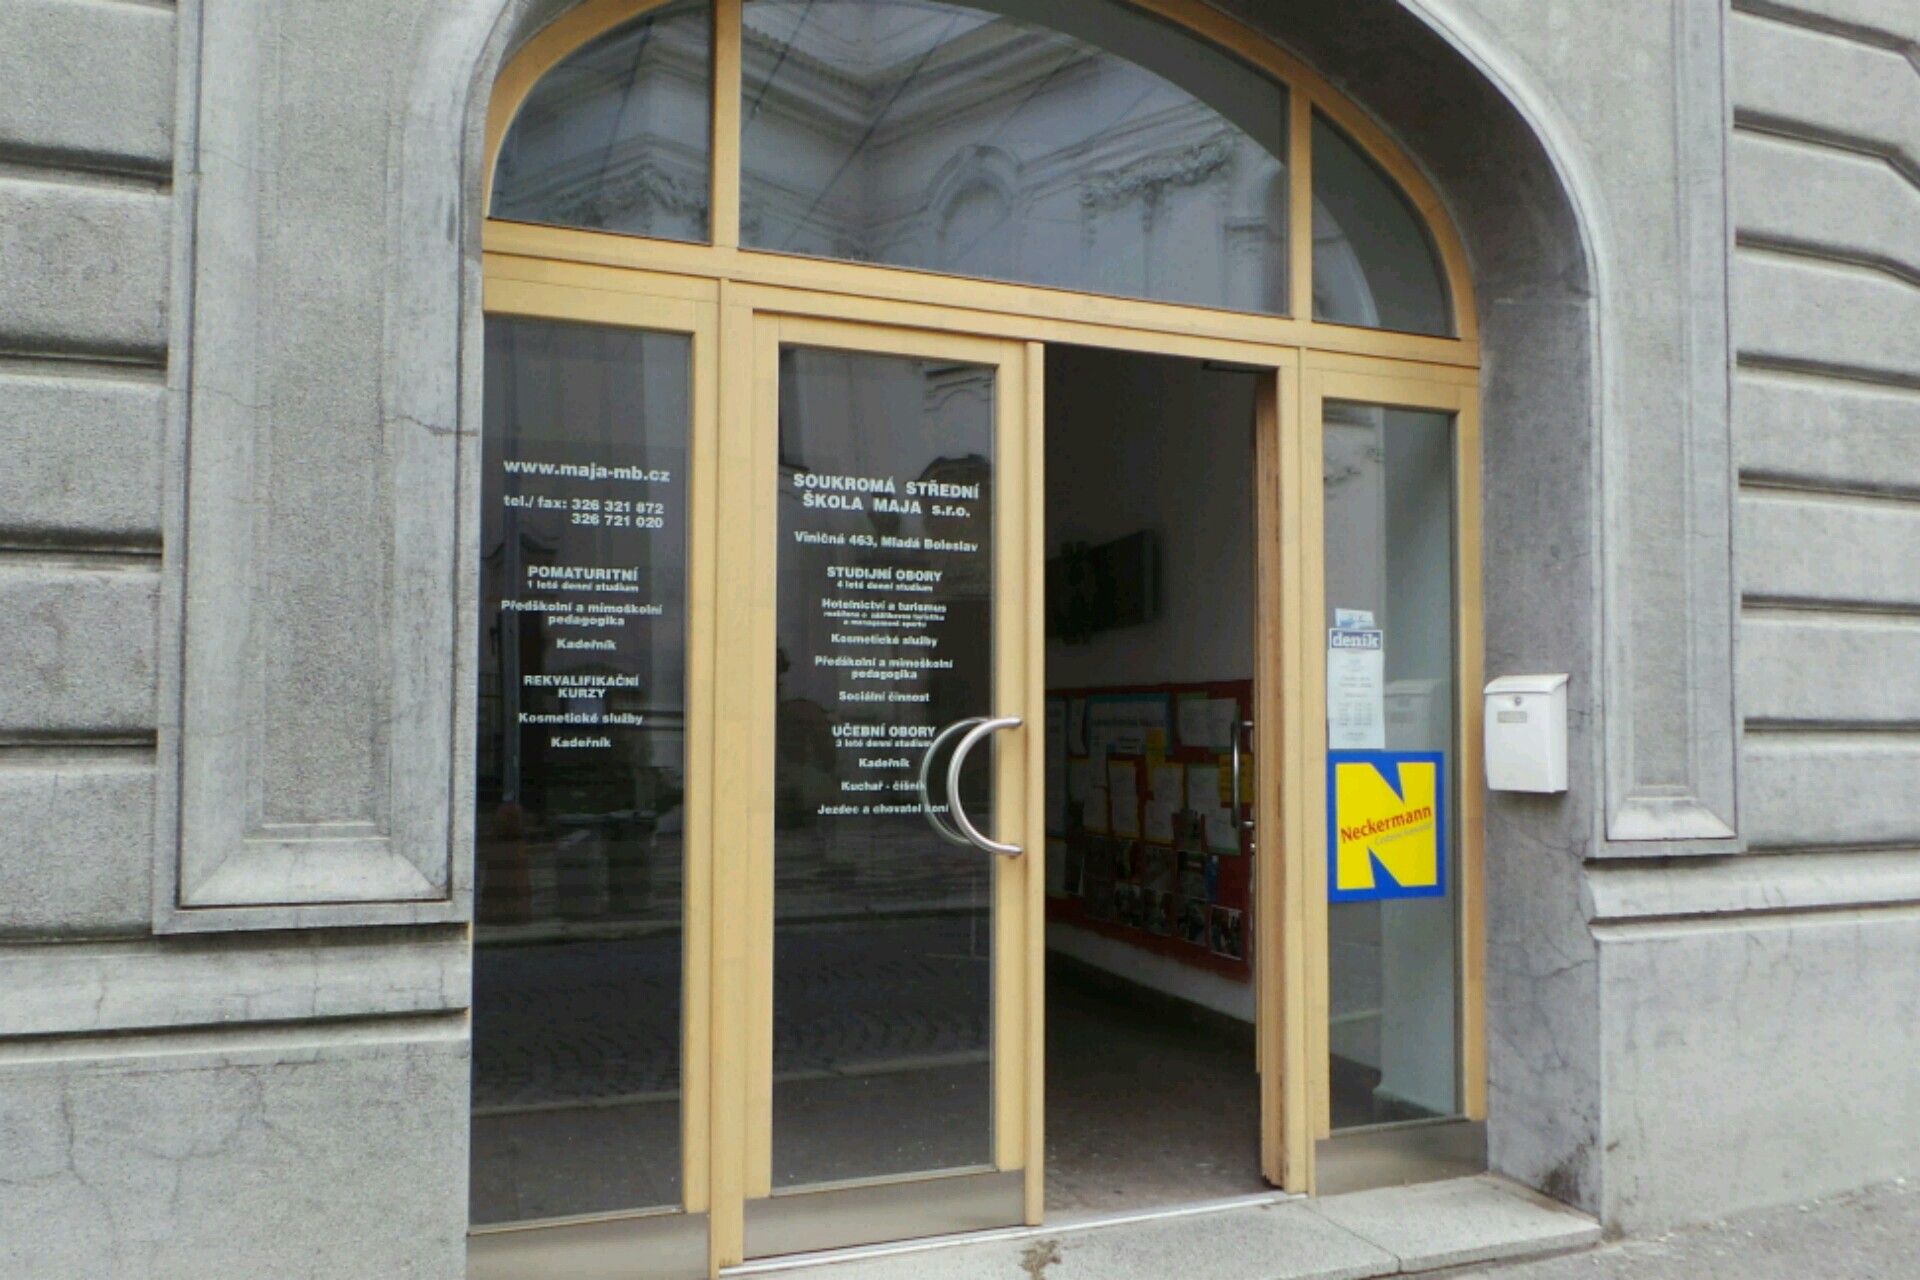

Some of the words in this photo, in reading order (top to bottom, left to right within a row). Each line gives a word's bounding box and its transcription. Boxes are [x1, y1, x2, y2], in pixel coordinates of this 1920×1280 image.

[503, 460, 671, 482] www.maja-mb.cz
[793, 473, 896, 494] SOUKROMÁ
[906, 480, 980, 499] STŘEDNÍ
[537, 496, 567, 509] fax:
[571, 498, 600, 511] 326
[604, 500, 631, 513] 321
[635, 502, 664, 515] 872
[803, 489, 864, 511] ŠKOLA
[873, 498, 922, 515] MAJA
[932, 504, 971, 518] s.r.o.
[571, 513, 600, 526] 326
[604, 514, 631, 527] 721
[635, 516, 664, 528] 020
[794, 530, 845, 545] Viničná
[880, 535, 920, 549] Mladá
[924, 538, 979, 552] Boleslav
[527, 564, 639, 582] POMATURITNÍ
[827, 566, 892, 579] STUDIJNÍ
[895, 569, 942, 582] OBORY
[561, 581, 593, 591] denní
[595, 582, 639, 593] studium
[501, 600, 572, 613] Předškolní
[576, 603, 585, 612] a
[588, 602, 663, 616] mimoškolní
[822, 598, 886, 610] Hotelnictví
[888, 602, 896, 611] a
[898, 602, 947, 613] turismus
[548, 614, 625, 627] pedagogika
[556, 637, 617, 650] Kadeřník
[831, 633, 900, 645] Kosmetické
[902, 635, 938, 648] služby
[814, 655, 876, 668] Předškolní
[879, 659, 886, 667] a
[888, 657, 953, 669] mimoškolní
[523, 673, 640, 687] REKVALIFIKAČNÍ
[851, 669, 917, 680] pedagogika
[558, 688, 607, 699] KURZY
[839, 691, 886, 702] Sociální
[888, 691, 930, 703] činnost
[518, 712, 599, 724] Kosmetické
[602, 712, 643, 726] služby
[832, 723, 885, 738] UČEBNÍ
[889, 726, 936, 738] OBORY
[551, 736, 611, 749] Kadeřník
[859, 757, 910, 768] Kadeřník
[841, 780, 884, 791] Kuchař
[817, 804, 859, 815] Jezdec
[862, 806, 870, 815] a
[873, 803, 922, 815] chovatel
[1340, 806, 1432, 844] Neckermann
